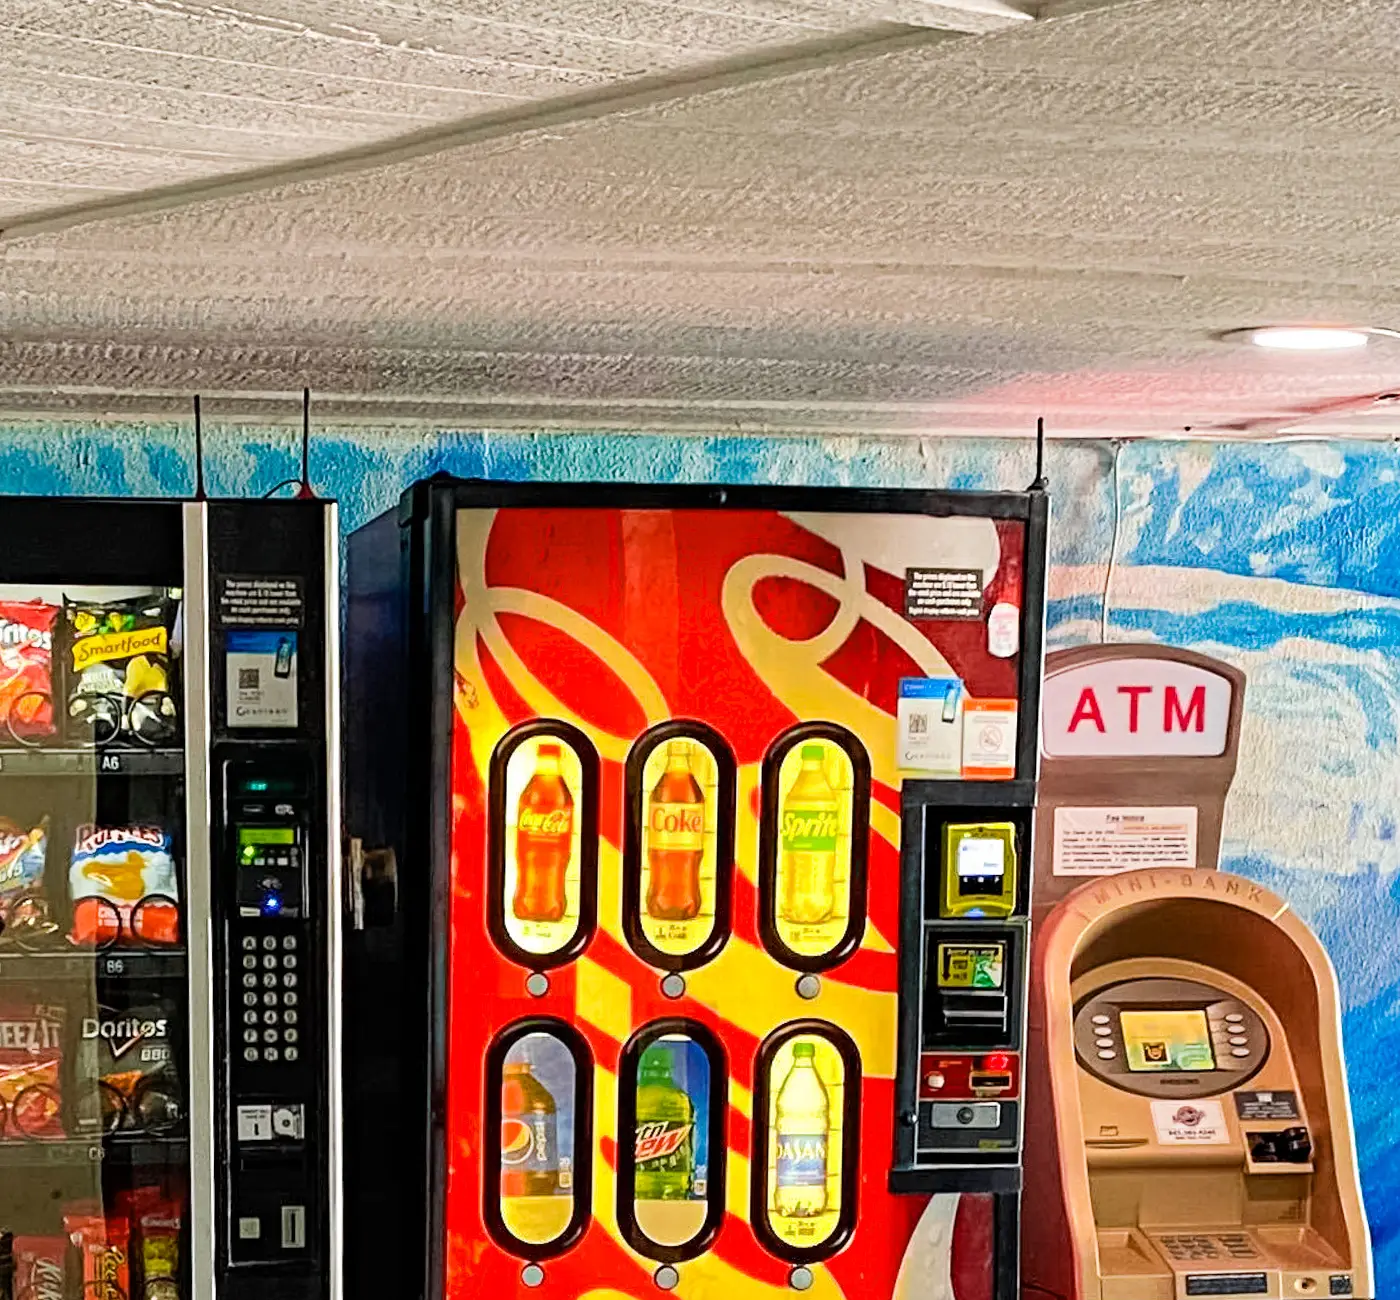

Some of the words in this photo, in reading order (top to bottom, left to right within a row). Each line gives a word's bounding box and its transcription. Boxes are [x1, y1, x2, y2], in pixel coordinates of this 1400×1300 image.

[0, 622, 52, 650] ritos
[79, 632, 162, 662] Smartfood
[1067, 685, 1206, 734] ATM
[102, 756, 119, 770] A6
[651, 807, 702, 833] Coke
[780, 811, 837, 842] Sprit
[107, 959, 124, 974] B6
[82, 1017, 168, 1039] Doritos
[535, 1120, 548, 1162] pepsi
[777, 1139, 826, 1164] DASAN
